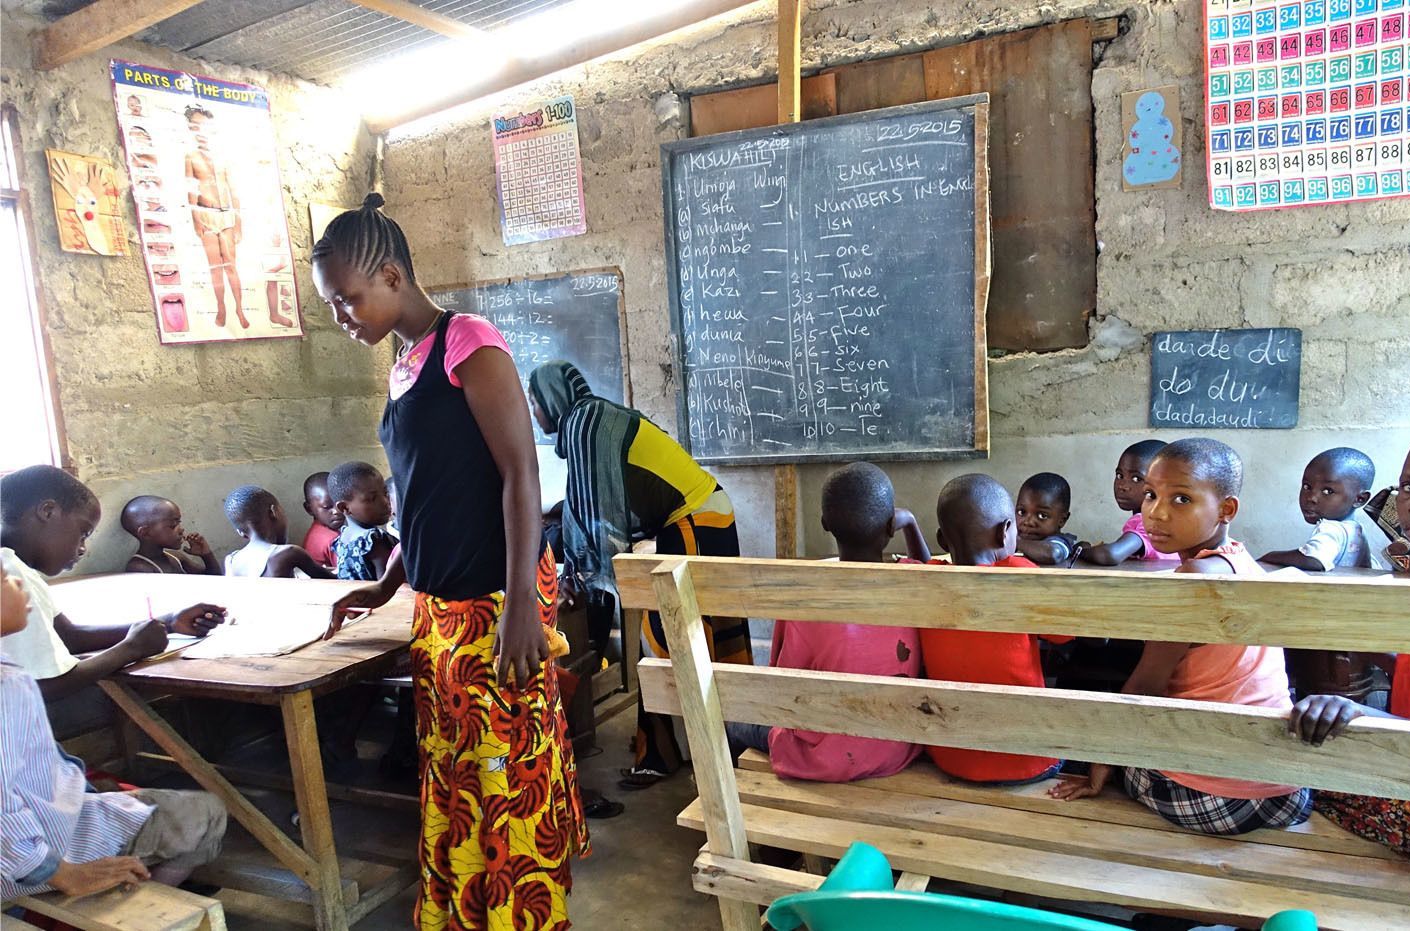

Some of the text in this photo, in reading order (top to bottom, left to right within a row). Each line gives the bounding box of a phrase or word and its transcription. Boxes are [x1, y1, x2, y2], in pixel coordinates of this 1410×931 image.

[124, 69, 257, 104] PARTS O THE BODY
[494, 100, 573, 134] Numbers 1-100
[1213, 136, 1229, 148] 71
[1235, 133, 1253, 146] 72
[1259, 131, 1276, 143] 73
[1282, 128, 1300, 141] 74
[1307, 125, 1324, 138] 75
[1332, 122, 1350, 135] 76
[1356, 119, 1374, 133] 77
[1382, 115, 1401, 129] 78
[838, 154, 919, 181] ENGLISH
[1214, 162, 1230, 175] 81
[1236, 160, 1253, 172] 82
[1260, 158, 1277, 170] 83
[1284, 155, 1300, 168] 84
[1308, 153, 1324, 165] 85
[1332, 151, 1349, 164] 86
[1356, 148, 1374, 162] 87
[1382, 145, 1400, 158] 88
[914, 182, 932, 200] IN
[1216, 189, 1232, 201] 91
[1237, 188, 1254, 201] 92
[1261, 185, 1278, 198] 93
[1285, 183, 1303, 196] 94
[1309, 180, 1326, 194] 95
[1333, 180, 1351, 193] 96
[1357, 177, 1376, 189] 97
[1382, 173, 1401, 187] 98
[827, 217, 853, 231] ISH
[838, 263, 872, 279] Two
[838, 304, 888, 326] Four
[840, 376, 889, 398] Eight
